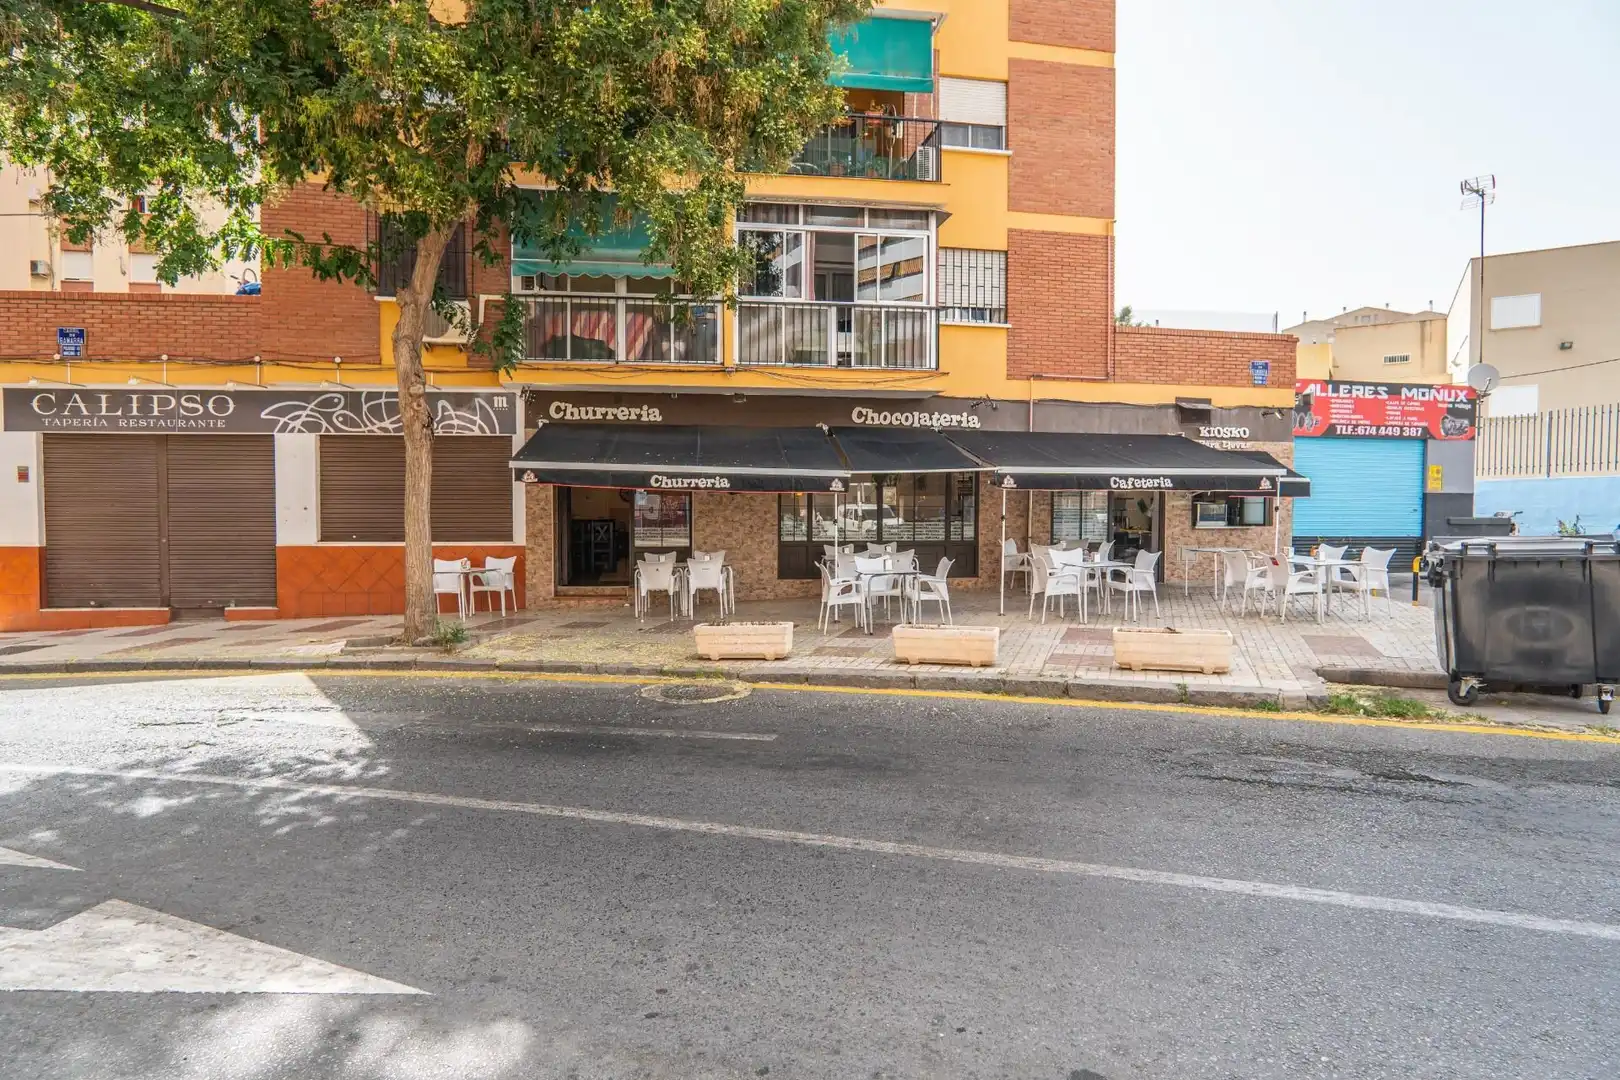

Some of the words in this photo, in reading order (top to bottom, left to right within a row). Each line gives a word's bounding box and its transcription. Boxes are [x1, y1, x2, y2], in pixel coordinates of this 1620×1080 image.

[1296, 383, 1388, 400] ALLERES
[1401, 384, 1468, 403] MOÑUX
[31, 393, 236, 417] CALIPSO
[549, 401, 663, 422] Churreria
[42, 417, 108, 427] TAPERÍA
[119, 418, 226, 428] RESTAURANTE
[851, 406, 981, 428] Chocolateria
[1199, 426, 1250, 438] KIOSKO
[1378, 425, 1400, 437] 449
[1402, 425, 1422, 437] 387
[650, 474, 731, 489] Churreria
[1109, 475, 1173, 490] Cafeteria
